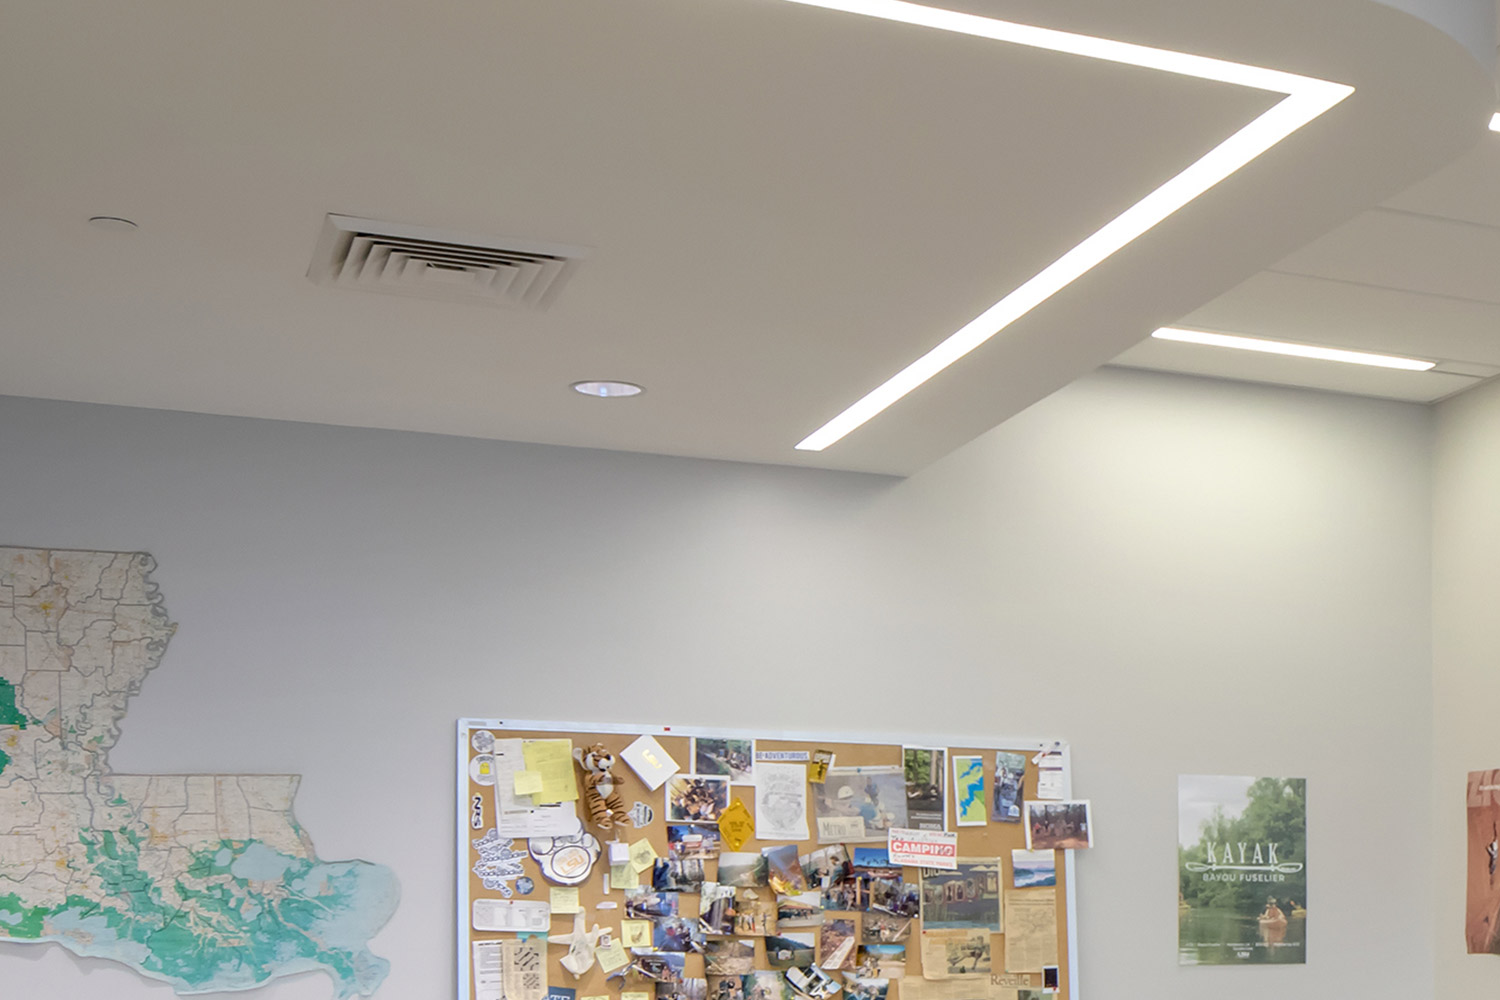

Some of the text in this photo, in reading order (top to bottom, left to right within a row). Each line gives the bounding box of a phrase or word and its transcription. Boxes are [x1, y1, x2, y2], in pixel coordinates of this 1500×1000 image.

[892, 841, 953, 856] CAMPING
[1207, 842, 1278, 864] KAYAK
[1203, 873, 1285, 882] BAYOU FUSELIER
